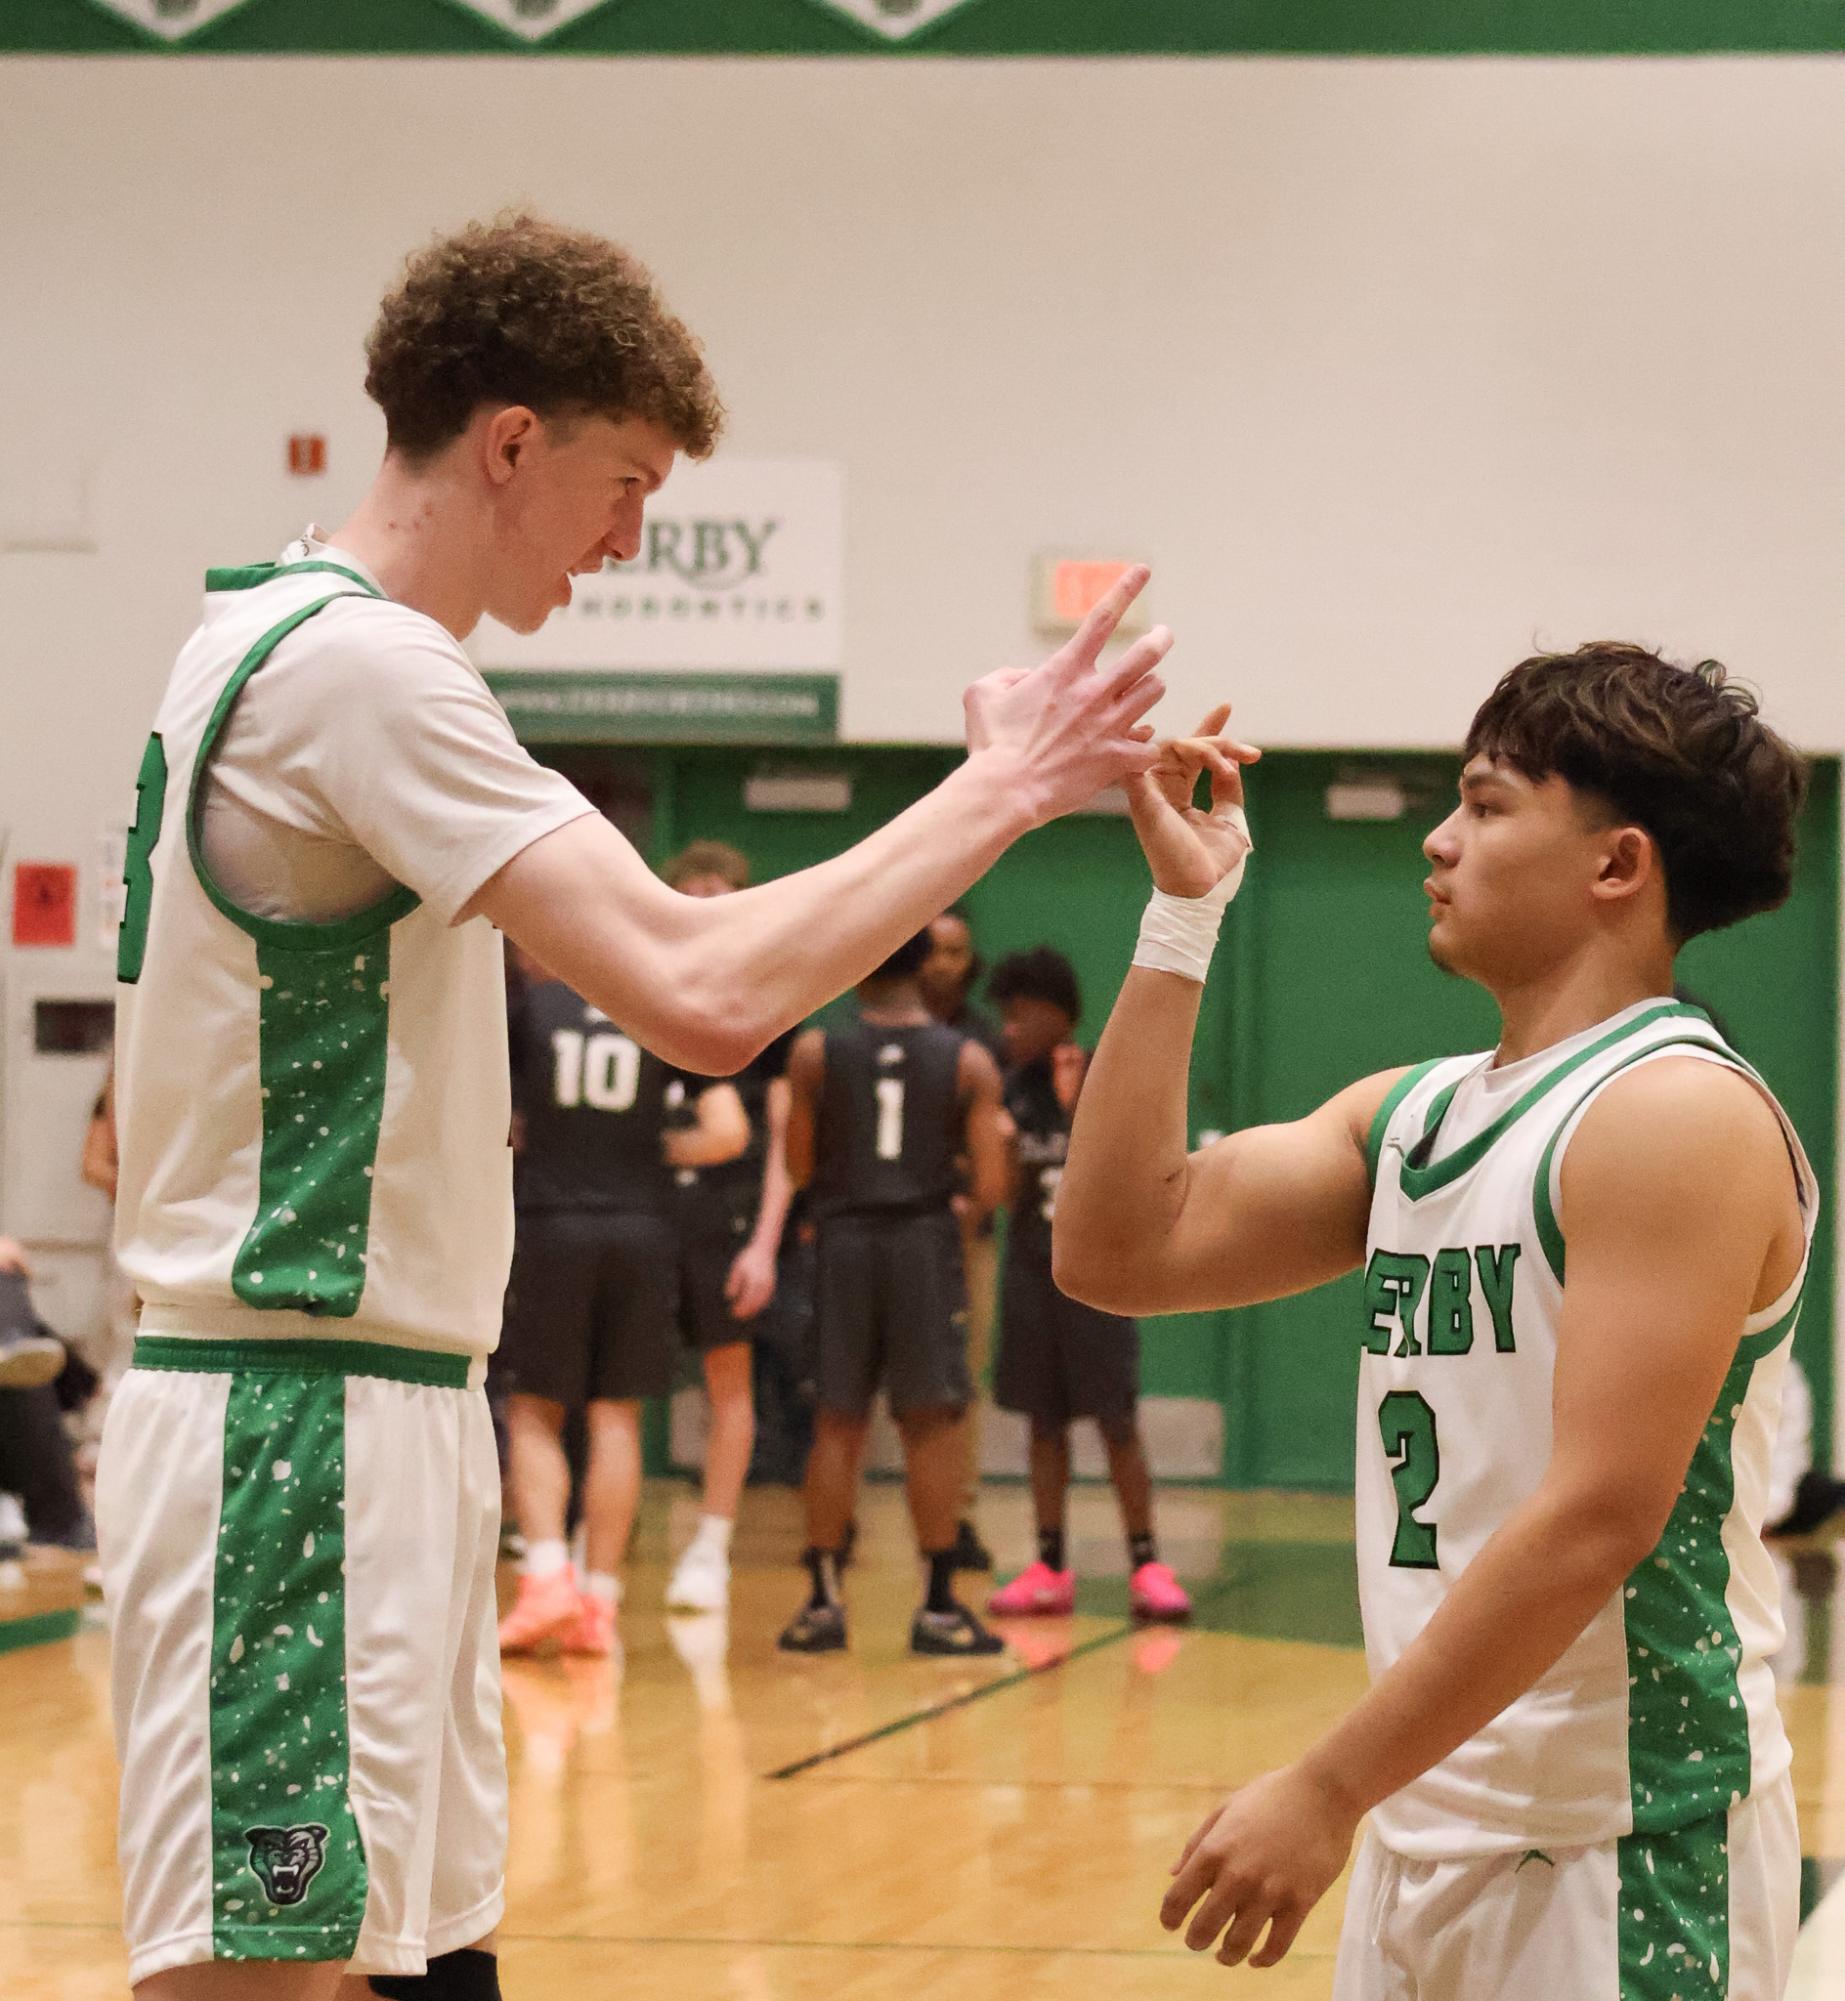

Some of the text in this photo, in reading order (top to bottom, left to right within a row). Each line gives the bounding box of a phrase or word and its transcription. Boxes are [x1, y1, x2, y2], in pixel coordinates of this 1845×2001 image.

[606, 518, 783, 591] RBY
[552, 1028, 641, 1112] 10
[877, 1078, 904, 1160] 1
[1363, 1243, 1522, 1358] ERBY
[1378, 1390, 1441, 1570] 2
